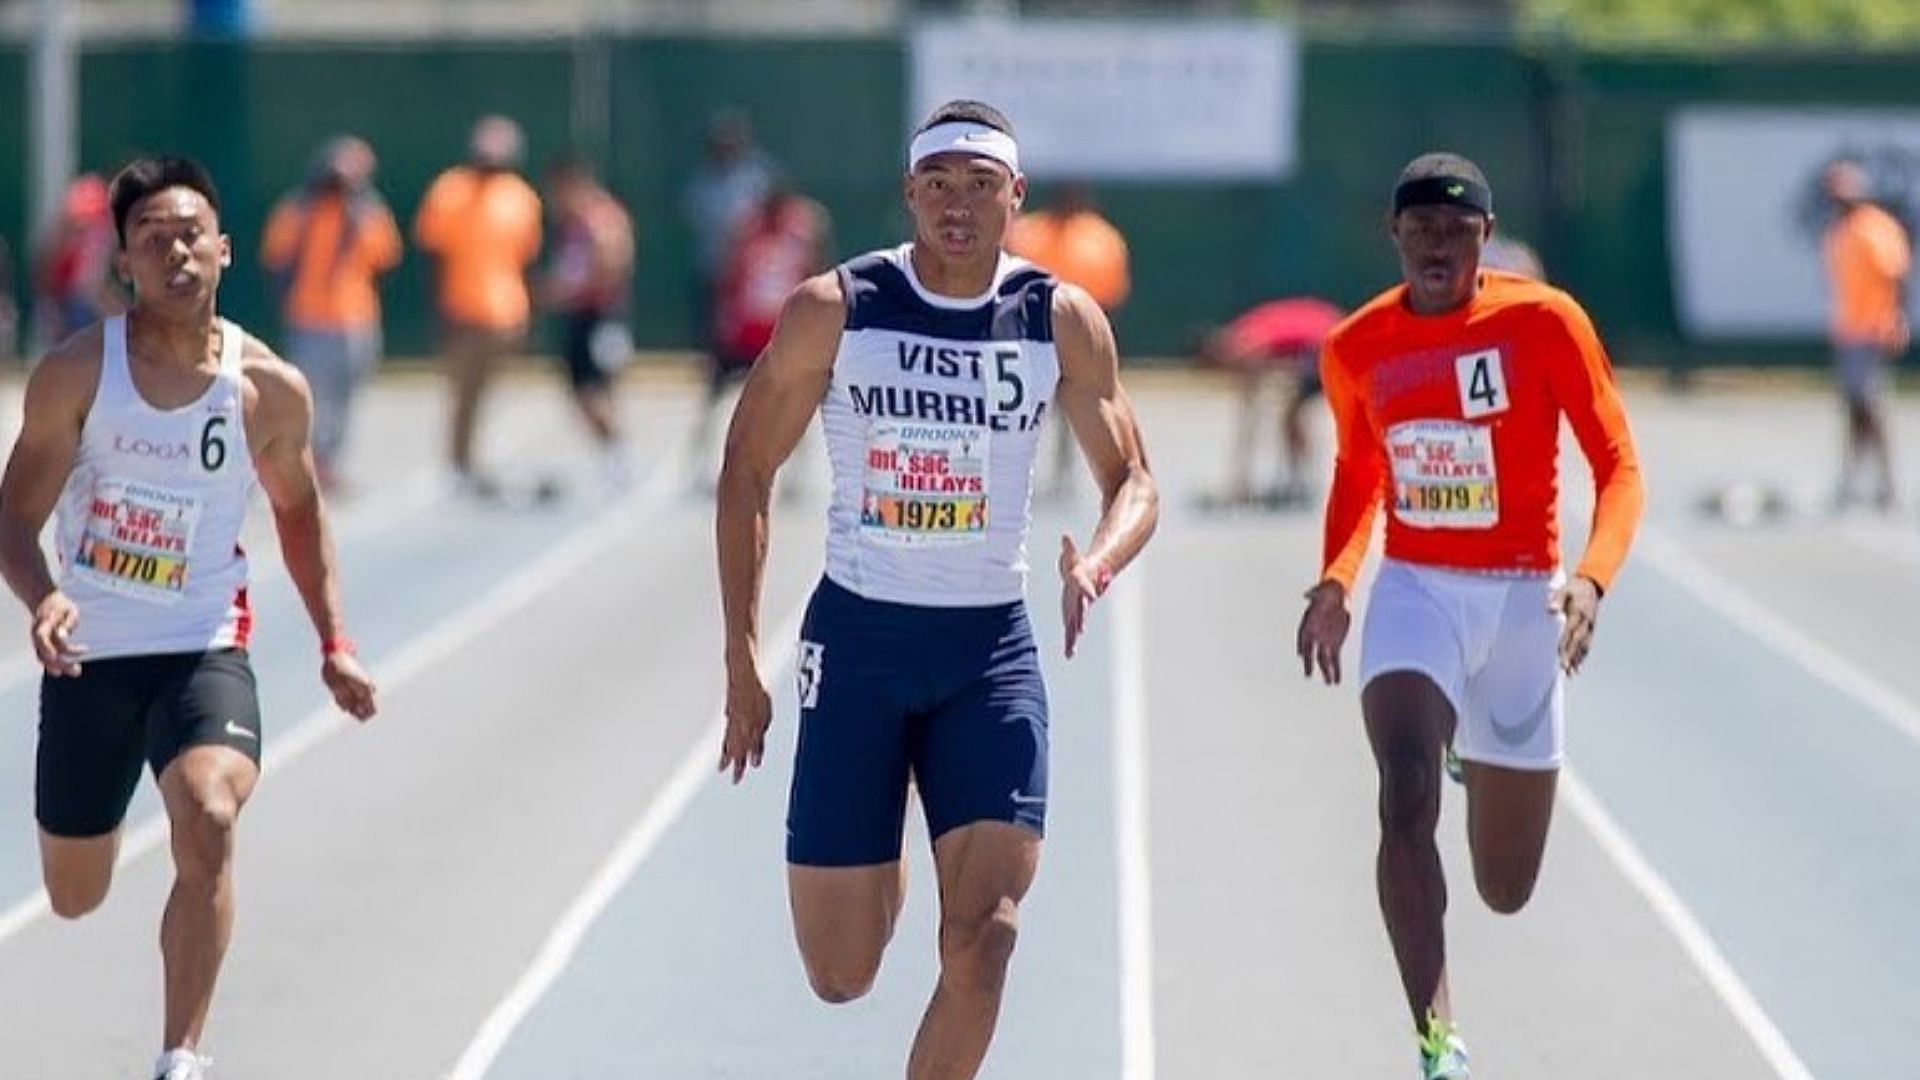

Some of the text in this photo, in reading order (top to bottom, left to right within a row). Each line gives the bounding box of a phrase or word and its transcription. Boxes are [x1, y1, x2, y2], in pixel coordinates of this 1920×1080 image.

[898, 341, 982, 380] VIST
[995, 351, 1024, 412] 5
[1468, 358, 1497, 407] 4
[114, 435, 190, 458] LOGA
[201, 416, 226, 471] 6
[909, 453, 949, 474] sac
[901, 473, 982, 492] RELAYS
[1419, 485, 1470, 510] 1979
[896, 500, 956, 528] 1973
[117, 526, 186, 552] RELAYS
[110, 548, 158, 581] 1770
